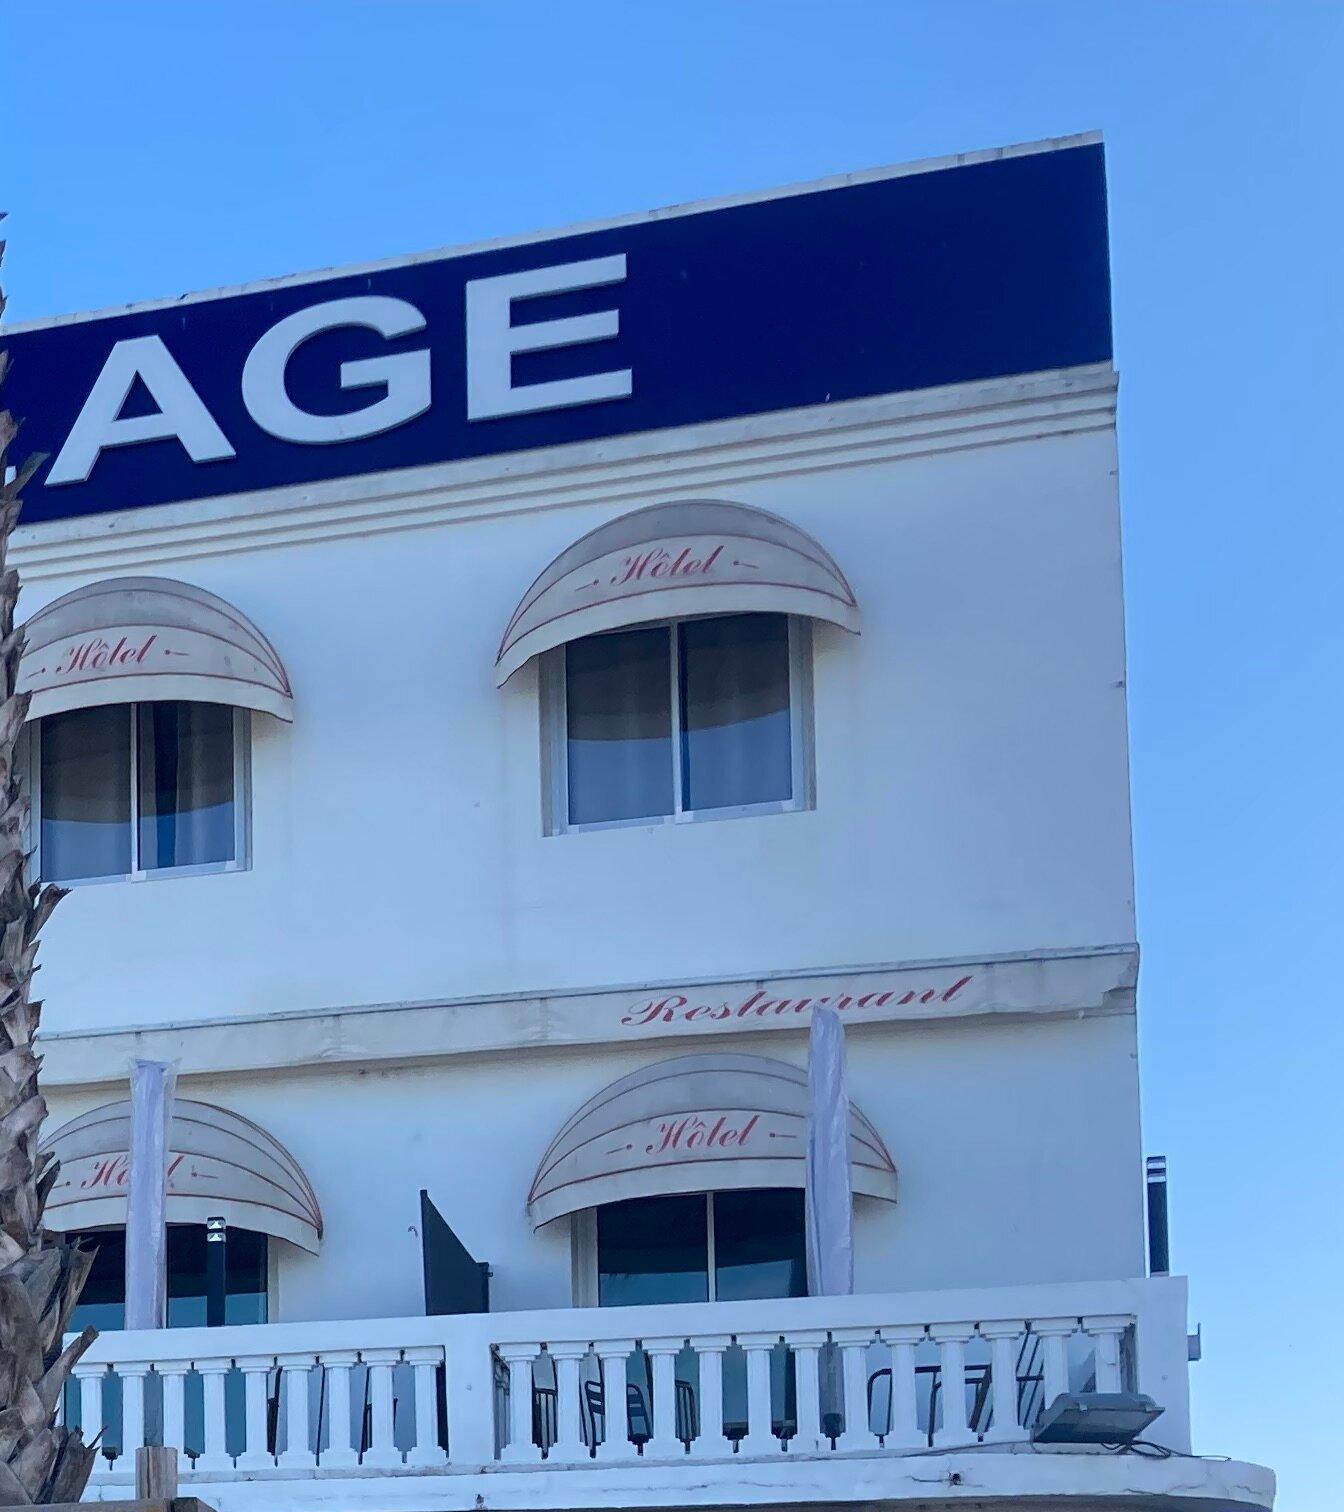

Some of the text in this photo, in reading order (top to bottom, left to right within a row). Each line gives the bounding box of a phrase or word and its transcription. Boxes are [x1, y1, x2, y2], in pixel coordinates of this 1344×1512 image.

[610, 545, 724, 584] Hôtel
[55, 634, 157, 674] Hôtel
[621, 975, 974, 1026] Restaurant
[645, 1115, 760, 1155] Hôtel
